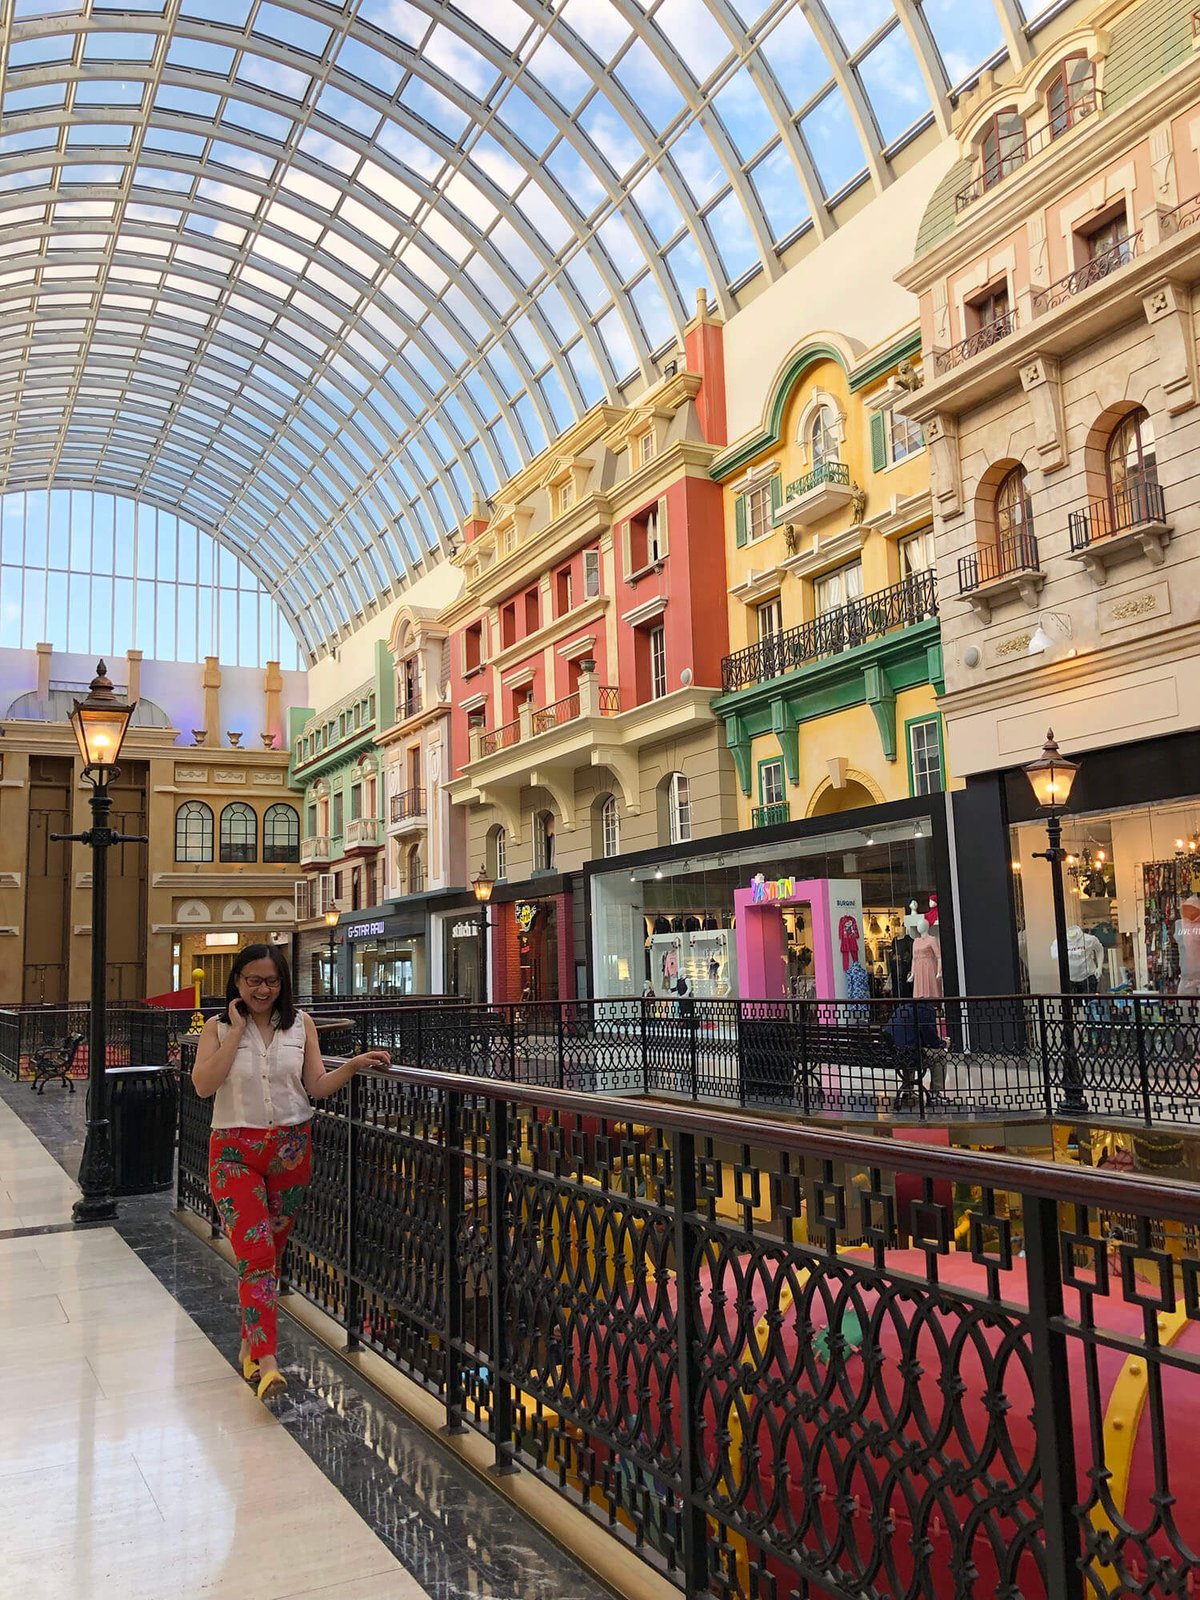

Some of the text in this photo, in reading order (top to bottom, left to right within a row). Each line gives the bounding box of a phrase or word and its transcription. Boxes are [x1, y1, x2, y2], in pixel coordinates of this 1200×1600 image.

[751, 876, 796, 904] YASMIN
[348, 921, 385, 938] G-STAR RAW
